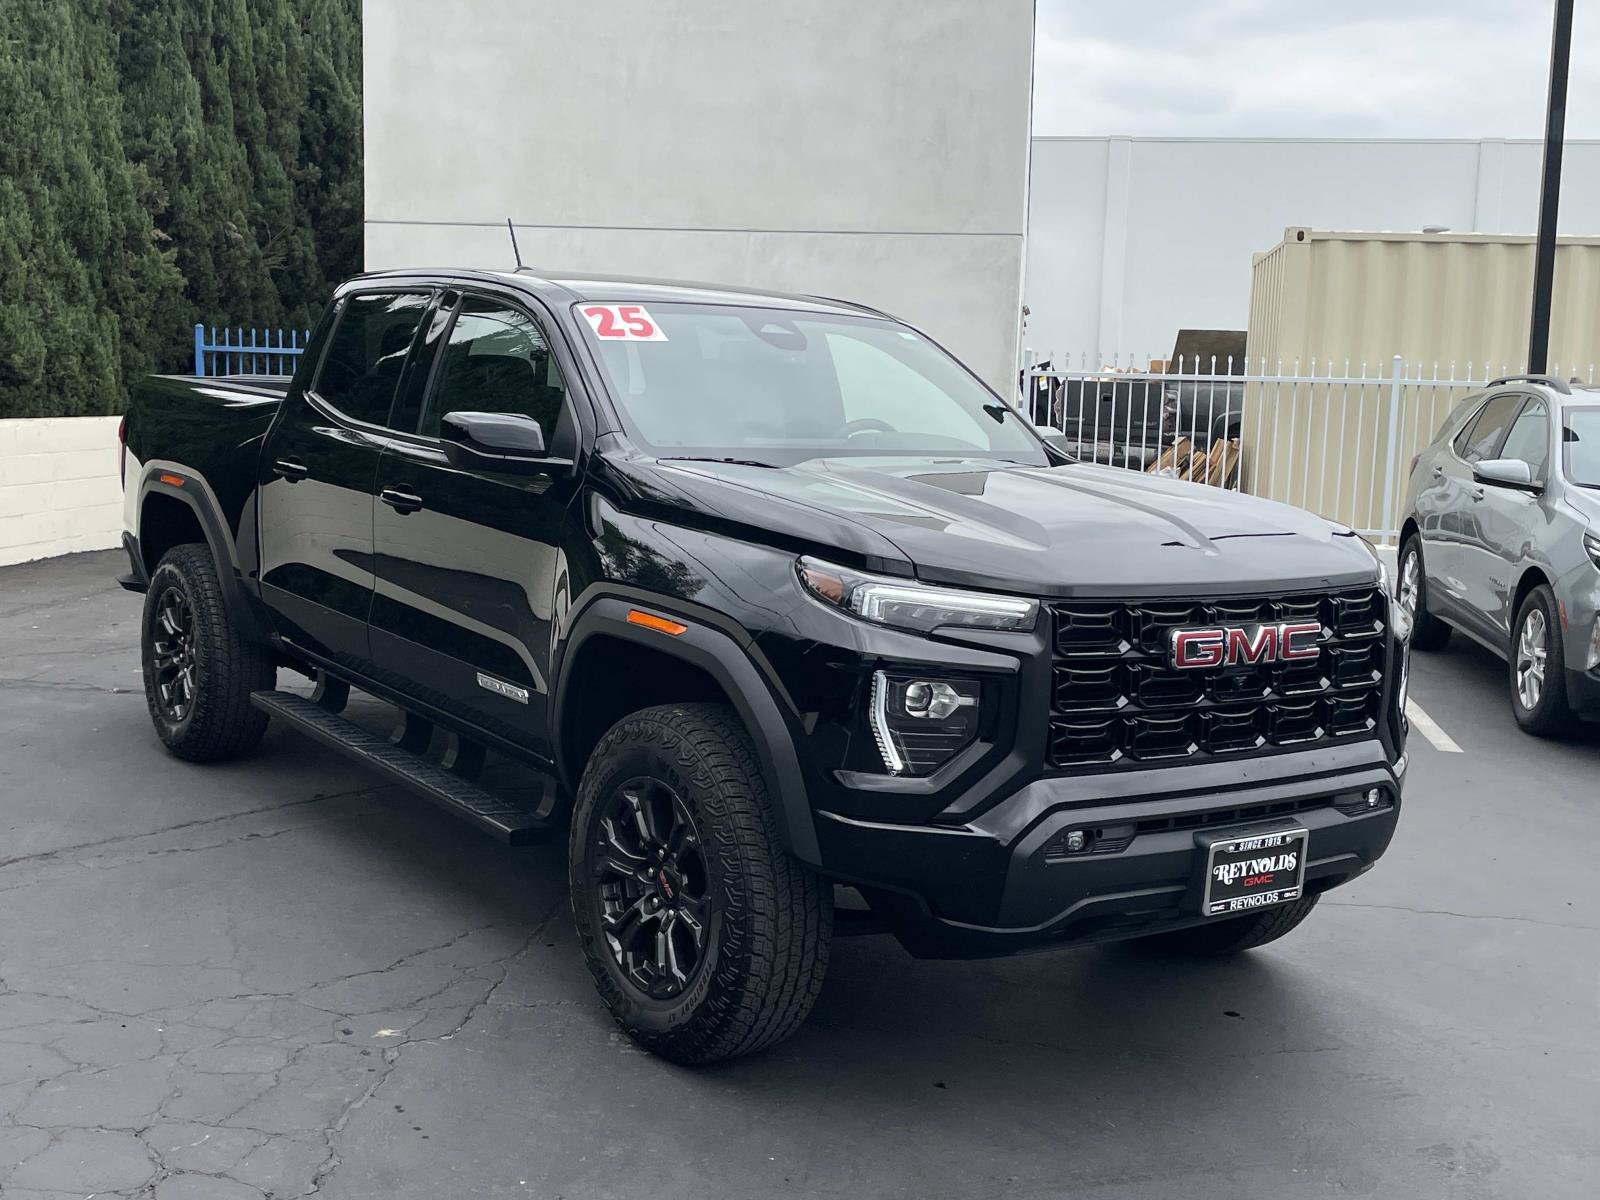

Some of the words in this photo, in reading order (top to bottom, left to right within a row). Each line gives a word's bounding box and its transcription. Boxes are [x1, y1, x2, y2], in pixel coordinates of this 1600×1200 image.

[583, 307, 654, 337] 25
[1172, 623, 1321, 669] GMC
[1239, 839, 1262, 851] SINCE
[1264, 836, 1282, 847] 1915
[1213, 852, 1297, 885] REYNOLDS
[1243, 874, 1274, 887] GMC
[1211, 904, 1225, 912] GMC
[1230, 892, 1279, 911] REYNOLDS
